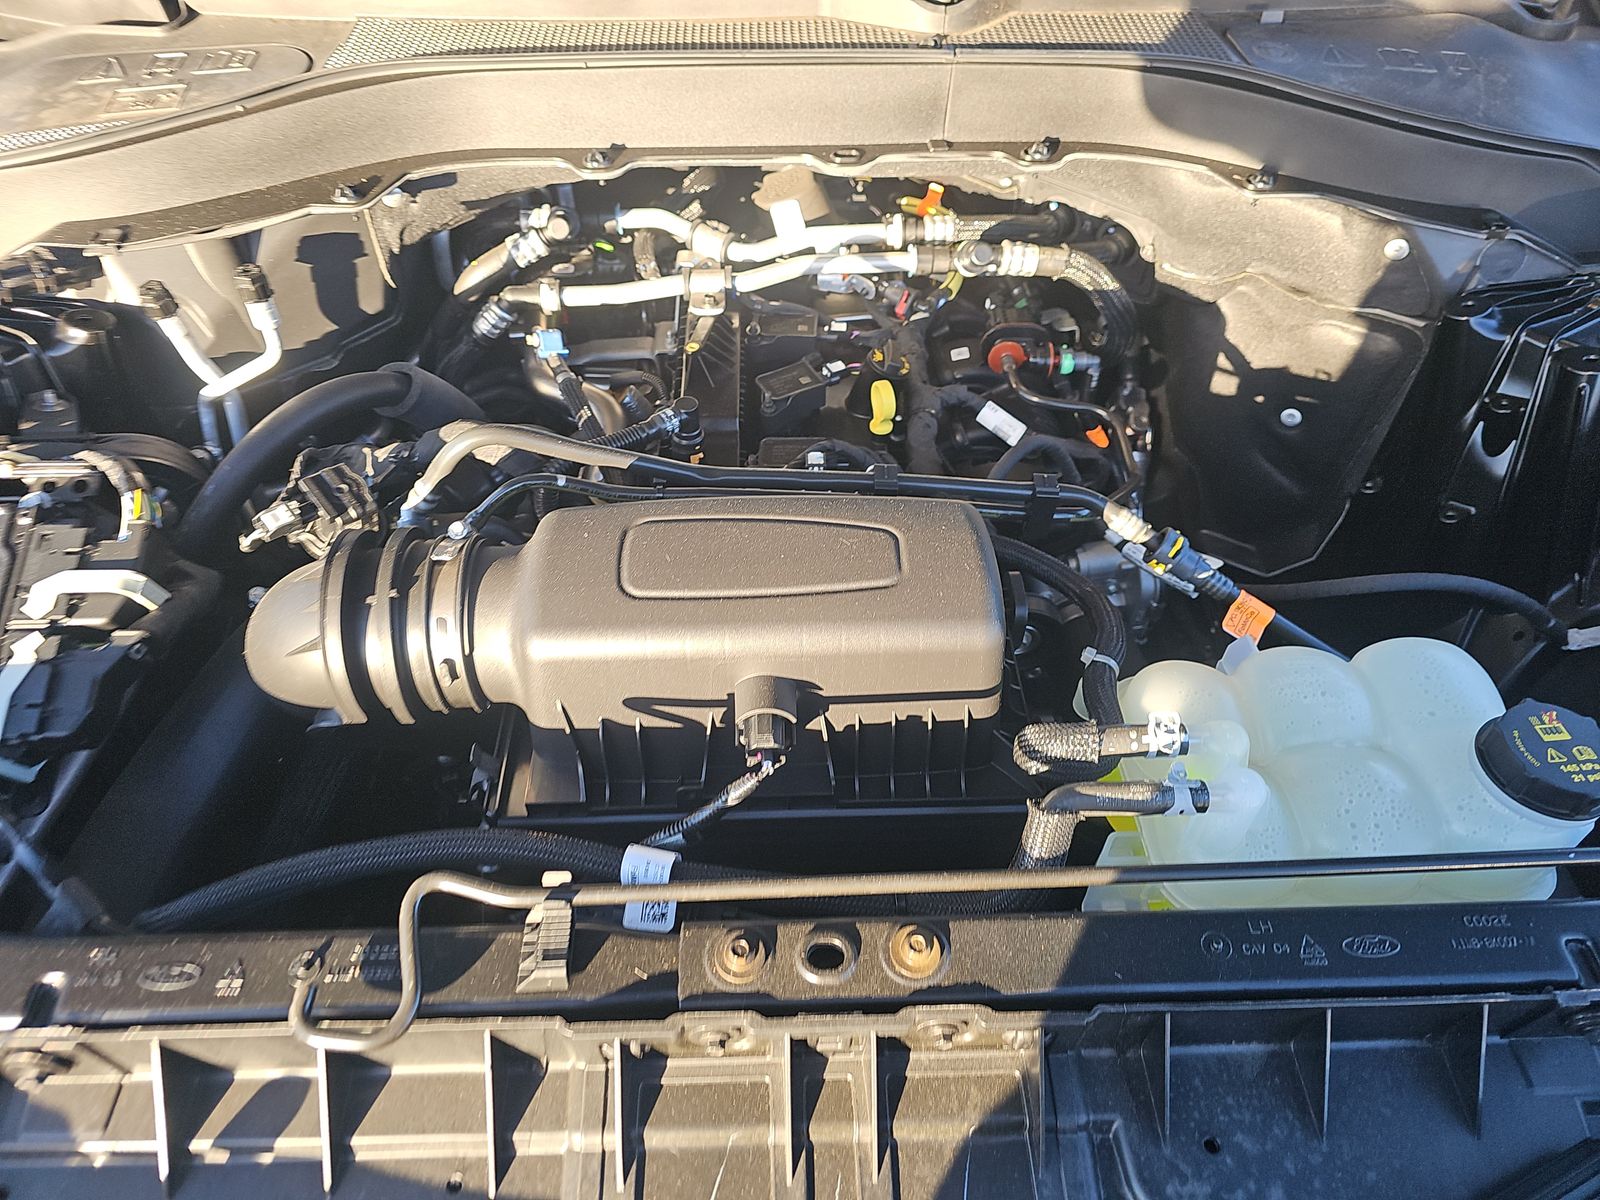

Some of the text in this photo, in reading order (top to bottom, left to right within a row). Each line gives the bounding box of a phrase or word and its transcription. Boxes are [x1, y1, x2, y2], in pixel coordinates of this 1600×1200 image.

[1571, 771, 1600, 783] 21 ps
[1247, 920, 1274, 935] LH
